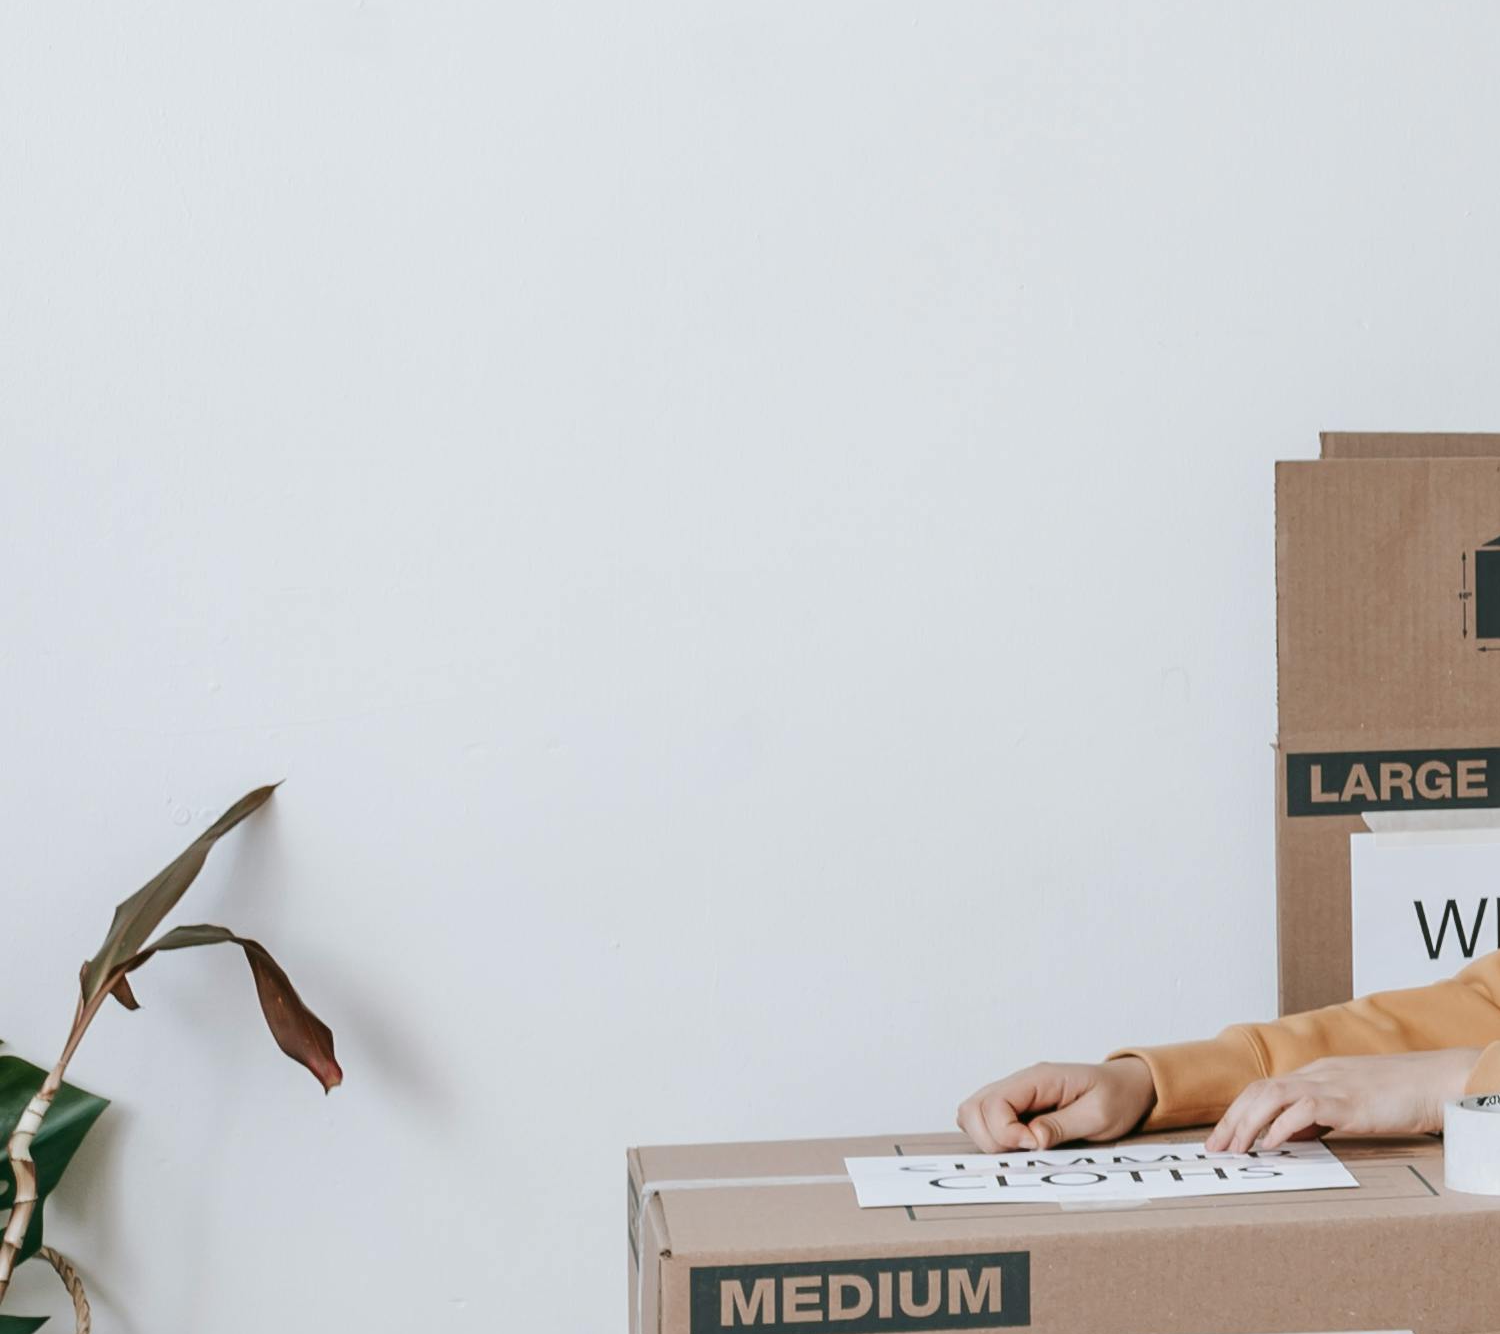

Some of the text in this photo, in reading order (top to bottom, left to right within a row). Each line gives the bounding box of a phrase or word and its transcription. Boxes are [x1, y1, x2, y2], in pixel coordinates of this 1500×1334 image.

[1310, 760, 1488, 803] LARGE
[929, 1165, 1283, 1189] CLOTHS
[720, 1267, 1001, 1326] MEDIUM
